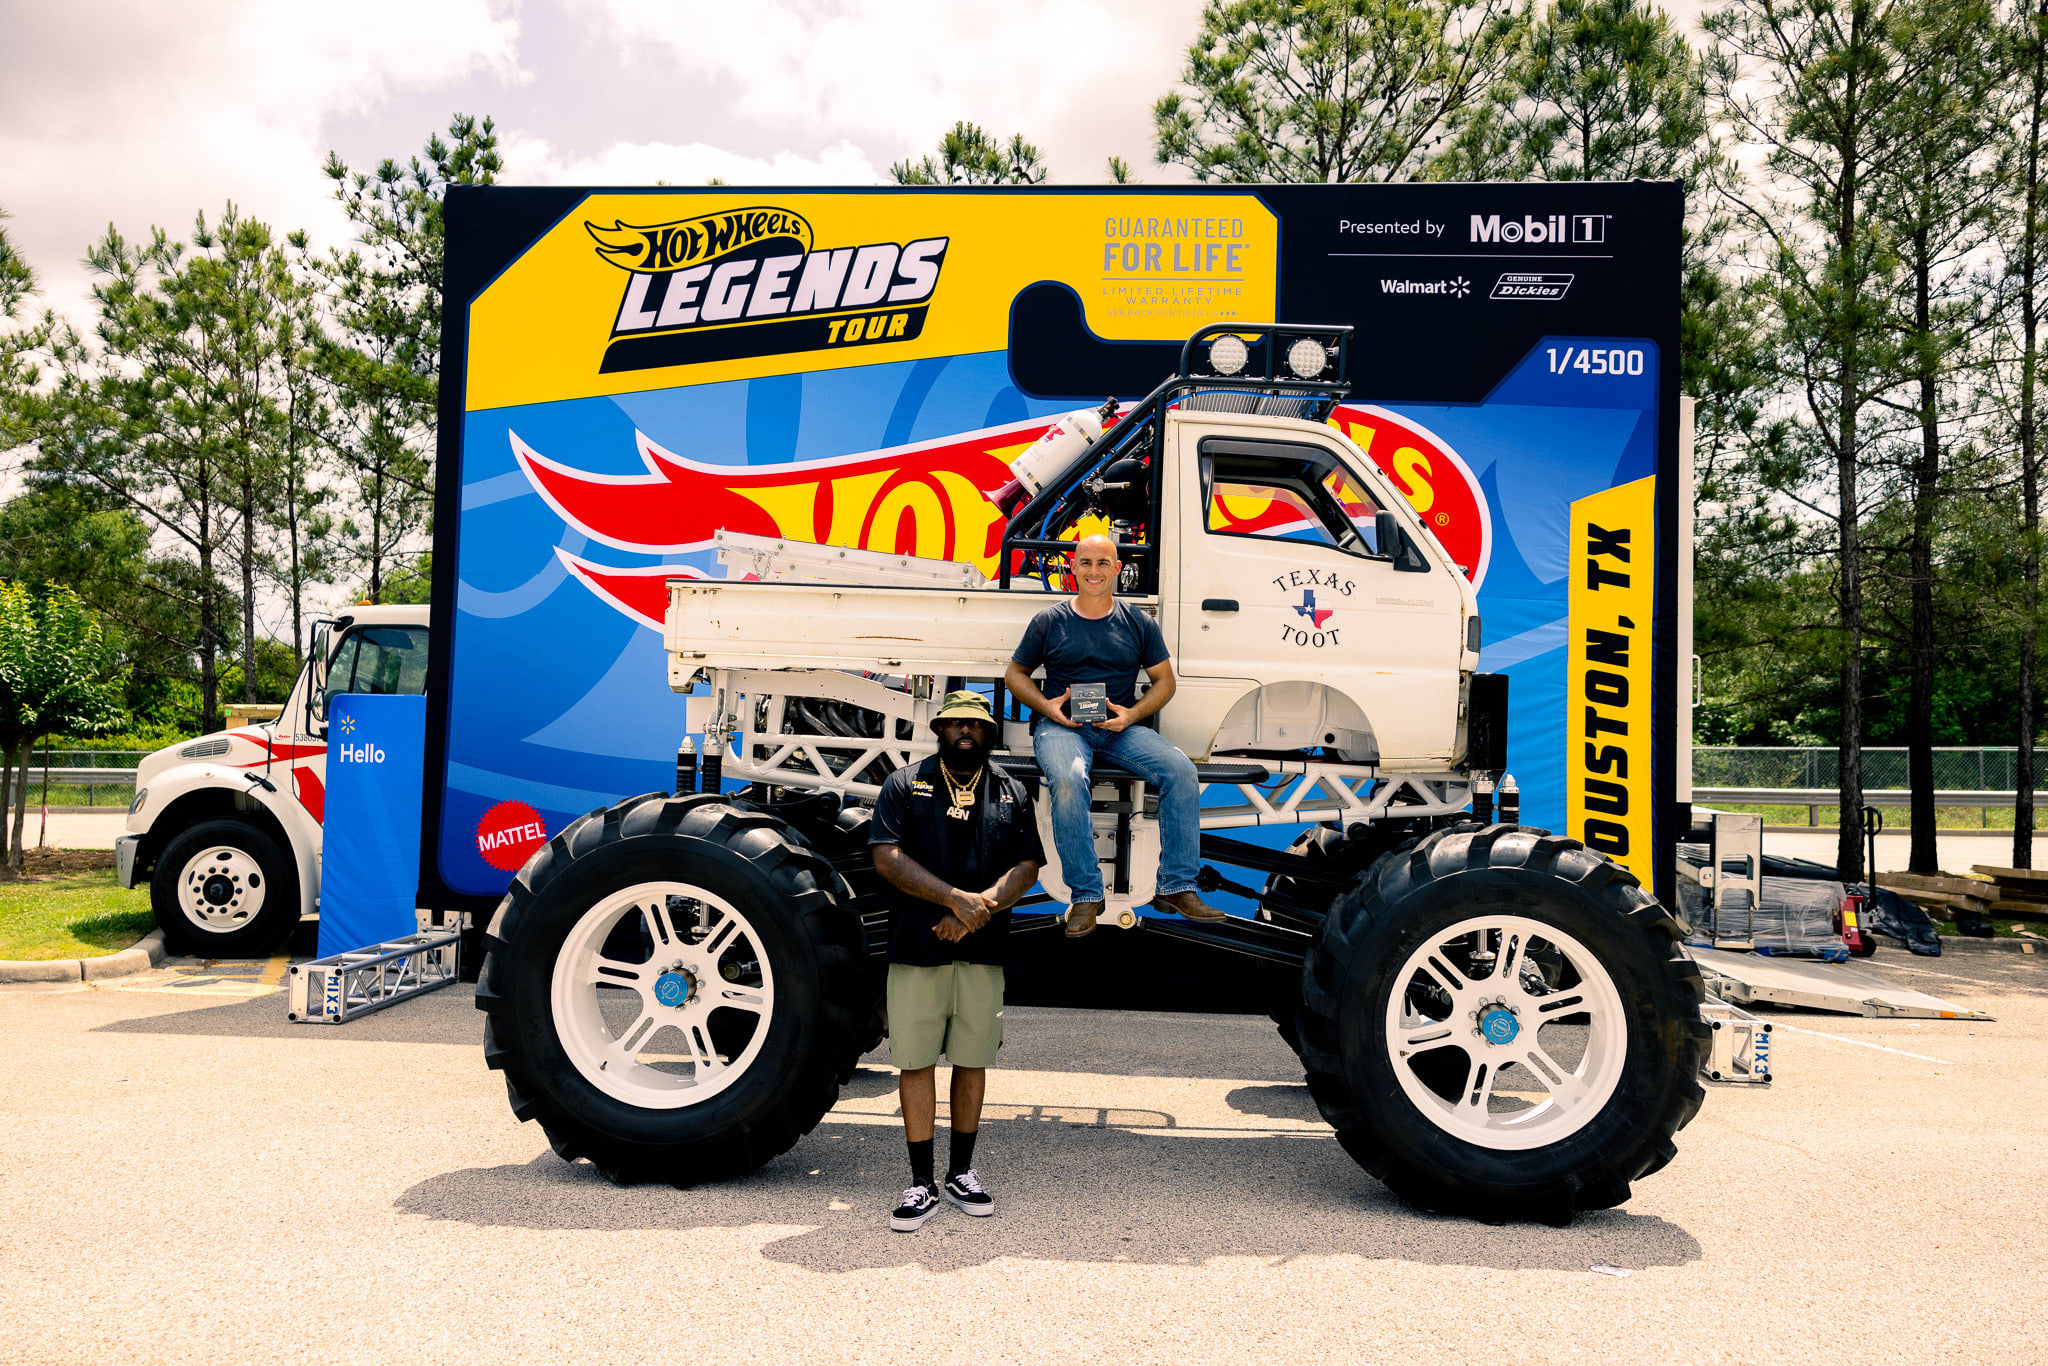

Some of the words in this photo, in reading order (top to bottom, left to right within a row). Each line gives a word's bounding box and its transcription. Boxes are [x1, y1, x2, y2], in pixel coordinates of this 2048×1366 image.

[1105, 217, 1243, 238] GUARANTEED
[1340, 220, 1420, 234] Presented
[1426, 220, 1445, 237] by
[1470, 215, 1566, 243] Mobil
[637, 227, 703, 268] HOT
[1104, 243, 1162, 271] FOR
[616, 238, 947, 332] LEGENDS
[1102, 287, 1164, 295] LIMITED
[1172, 287, 1242, 296] LIFETIME
[1381, 279, 1446, 294] Walmart
[1498, 285, 1560, 296] Dickies
[1107, 308, 1125, 316] SEE
[1127, 308, 1153, 316] BACK
[1156, 309, 1176, 317] FOR
[1178, 309, 1218, 317] DETAILS
[1126, 297, 1212, 305] WARRANTY
[828, 313, 909, 343] TOUR
[1547, 347, 1644, 376] 1/4500
[1587, 522, 1631, 592] TX
[1272, 569, 1356, 596] TEXAS
[1281, 623, 1340, 648] TOOT
[340, 743, 385, 763] Hello
[1584, 614, 1635, 870] OUSTON,
[478, 822, 547, 852] MATTEL
